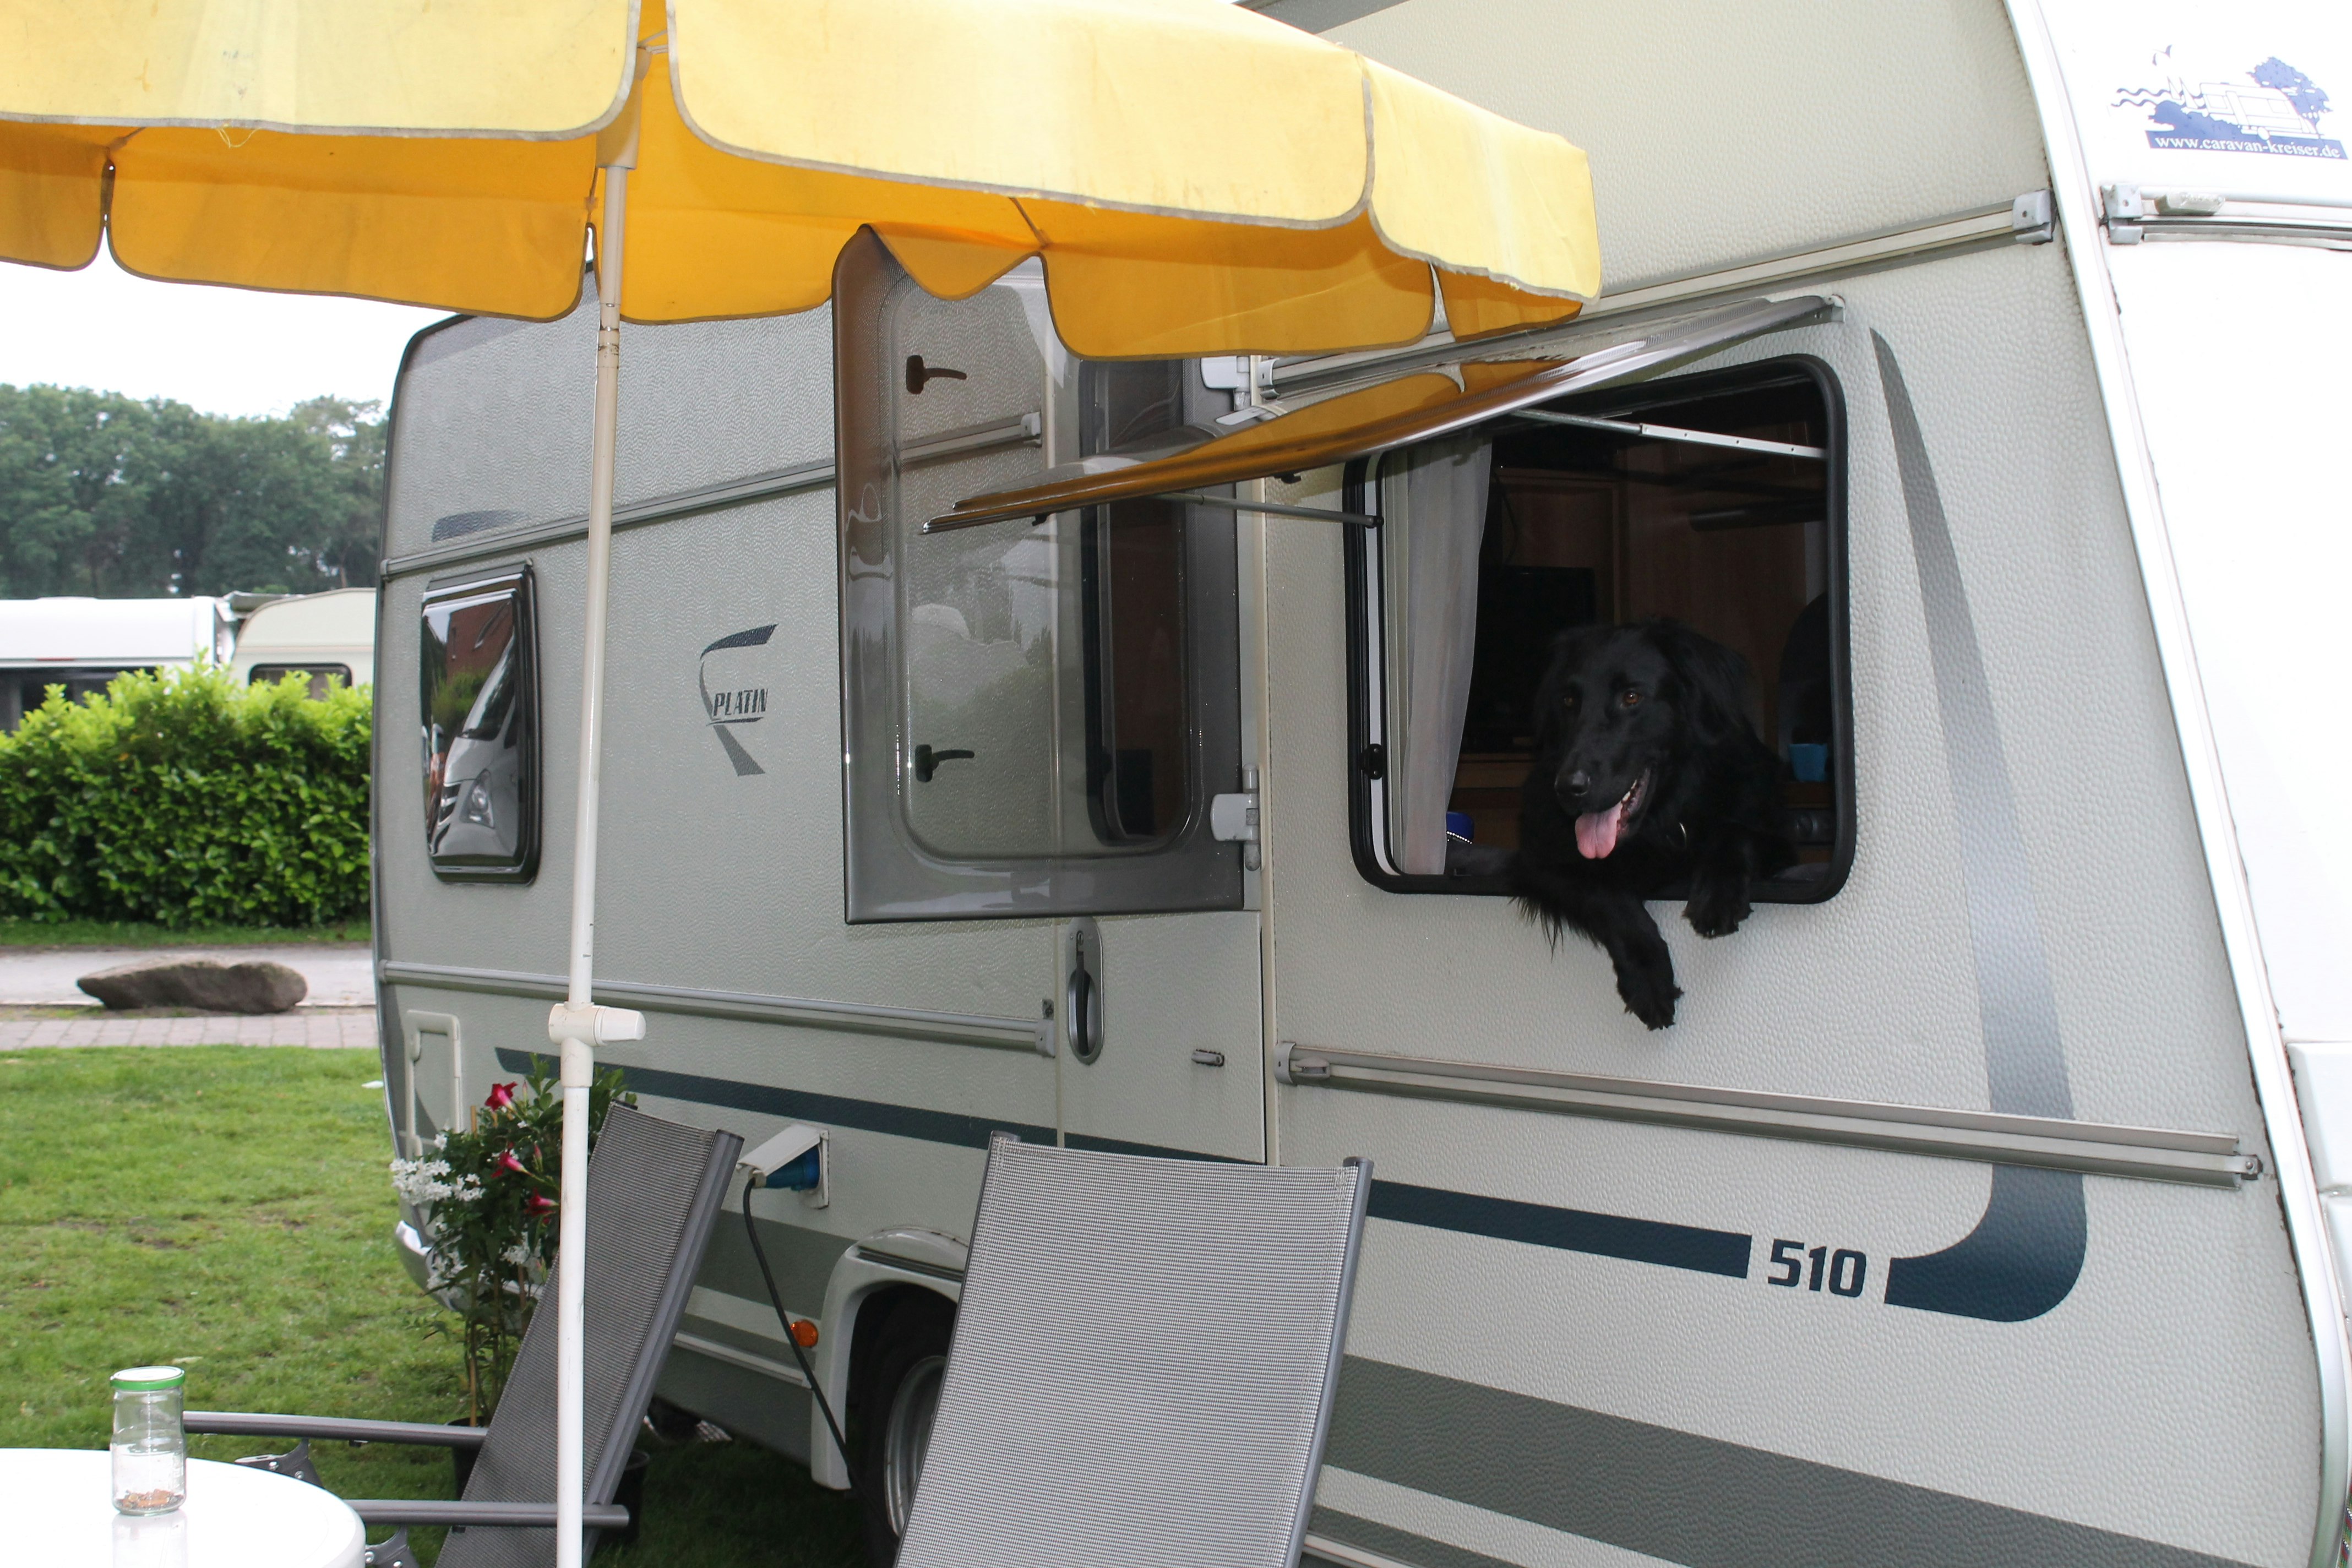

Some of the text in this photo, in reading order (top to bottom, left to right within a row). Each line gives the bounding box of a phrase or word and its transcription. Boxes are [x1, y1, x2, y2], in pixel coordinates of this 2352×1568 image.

[2154, 137, 2340, 159] www.caravan-kreiser.de
[713, 688, 769, 716] PLATIN
[1767, 1238, 1867, 1298] 510
